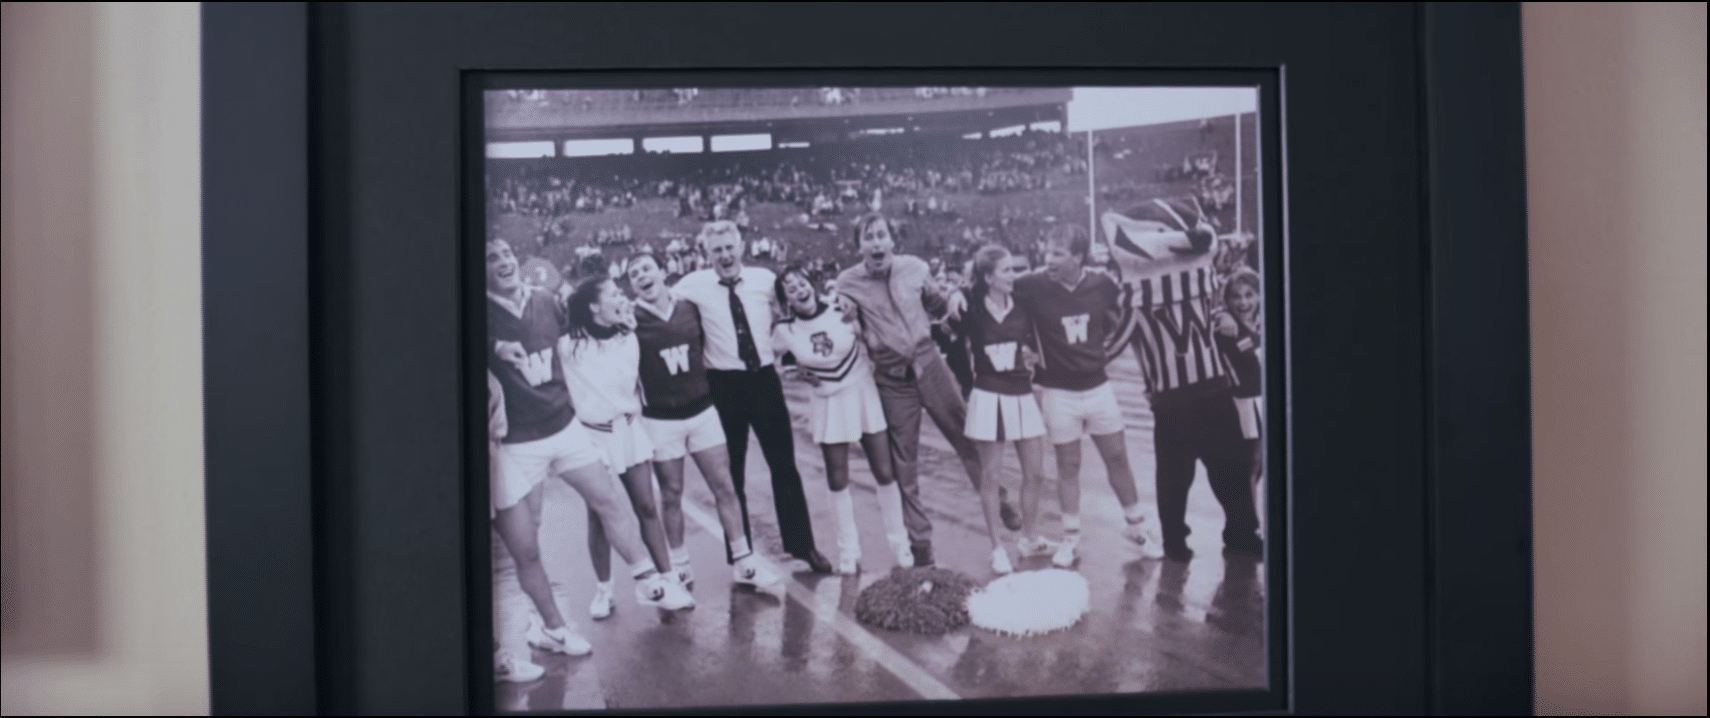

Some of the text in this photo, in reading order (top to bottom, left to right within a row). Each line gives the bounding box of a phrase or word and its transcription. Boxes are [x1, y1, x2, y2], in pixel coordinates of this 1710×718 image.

[1061, 313, 1090, 345] W
[520, 347, 553, 387] W
[659, 343, 690, 376] W
[984, 341, 1017, 372] W
